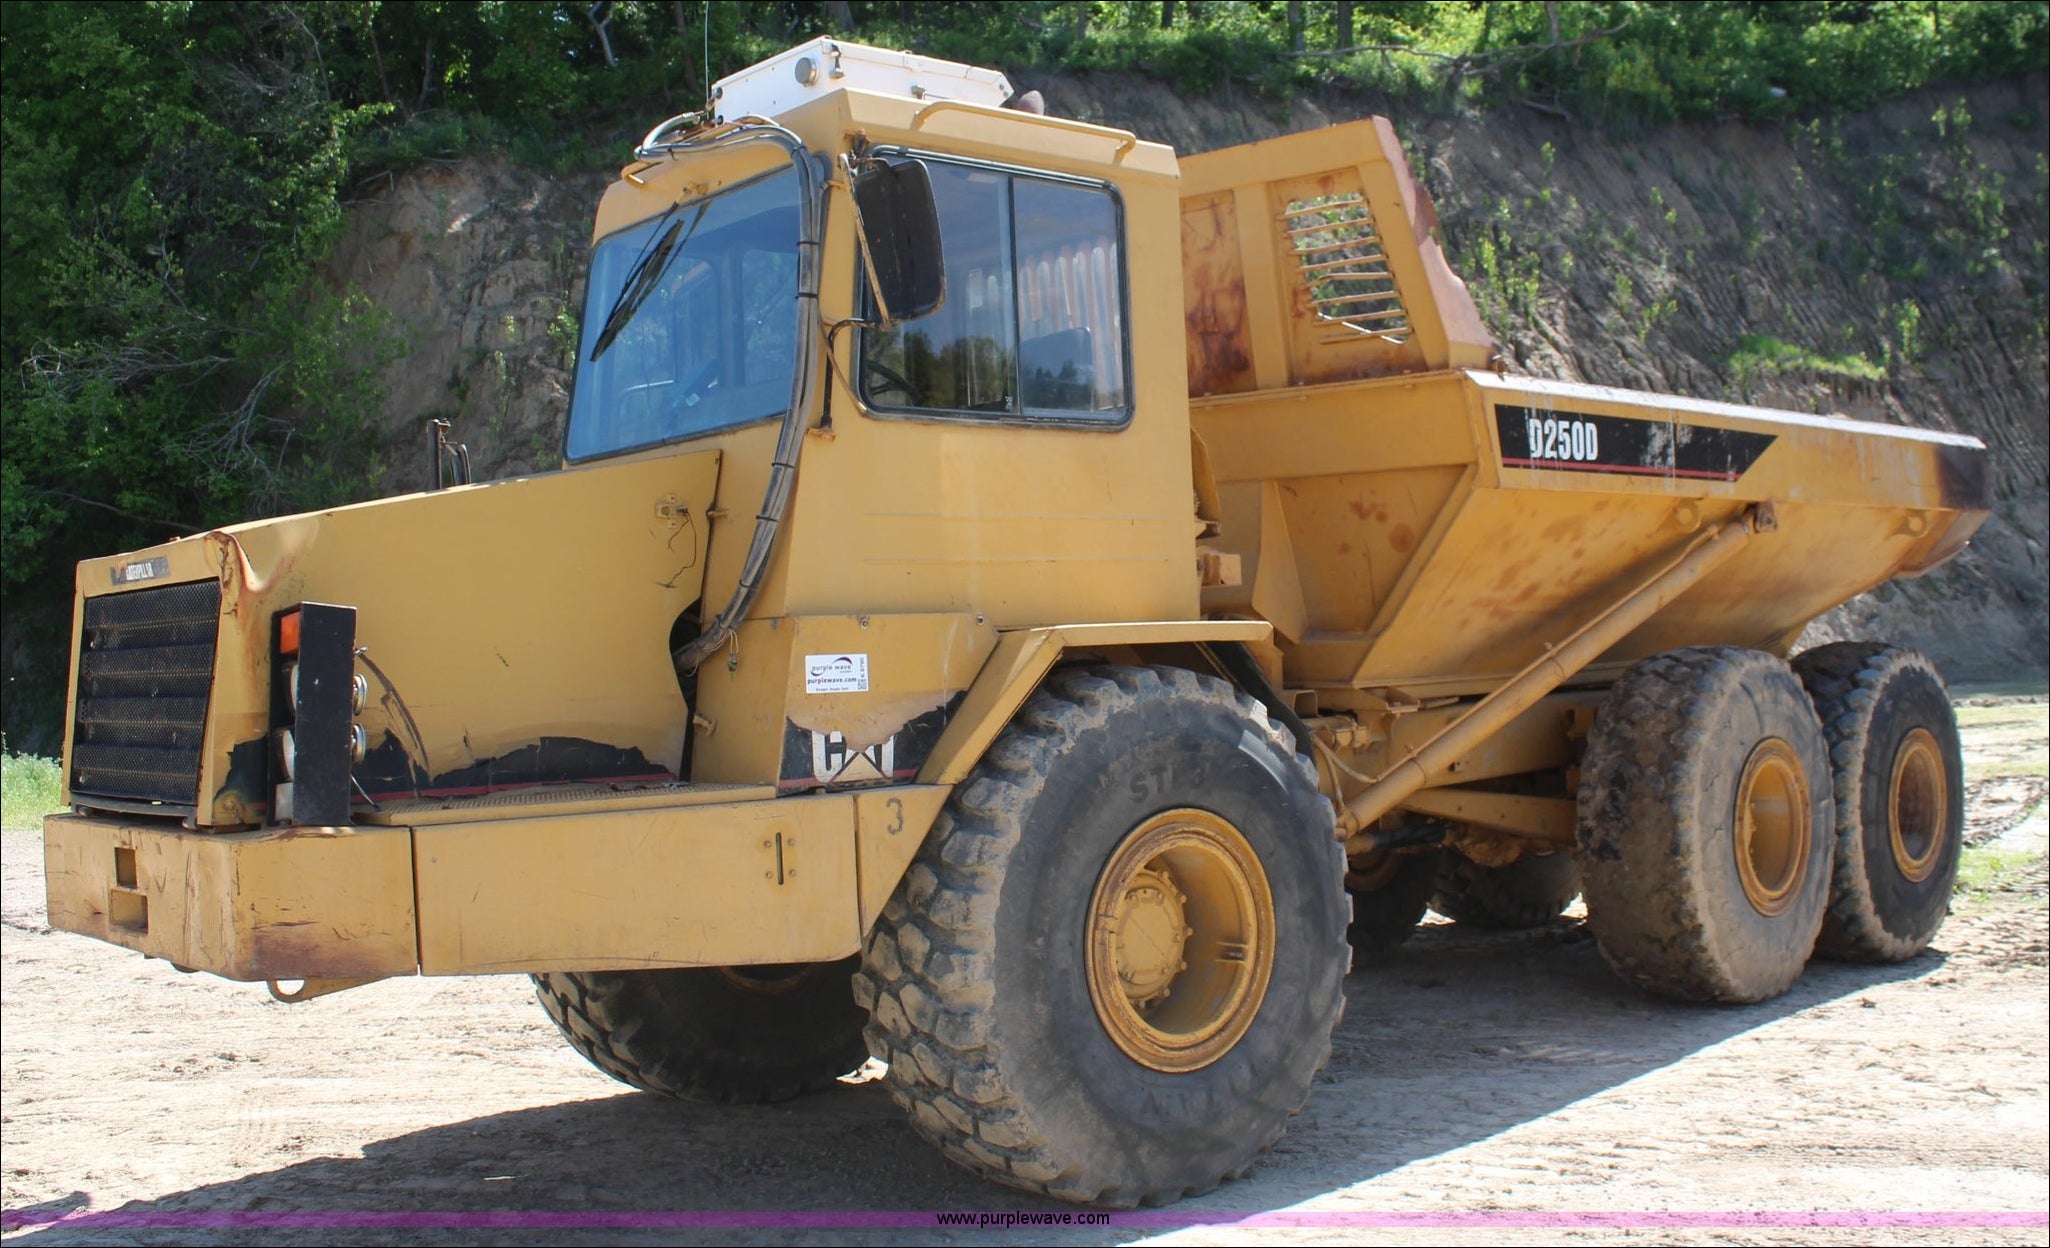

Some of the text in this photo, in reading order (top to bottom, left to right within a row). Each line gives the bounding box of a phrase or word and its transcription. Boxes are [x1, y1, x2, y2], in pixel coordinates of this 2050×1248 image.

[1529, 418, 1599, 461] D250D
[807, 677, 857, 685] purplewave.com
[886, 797, 904, 836] 3
